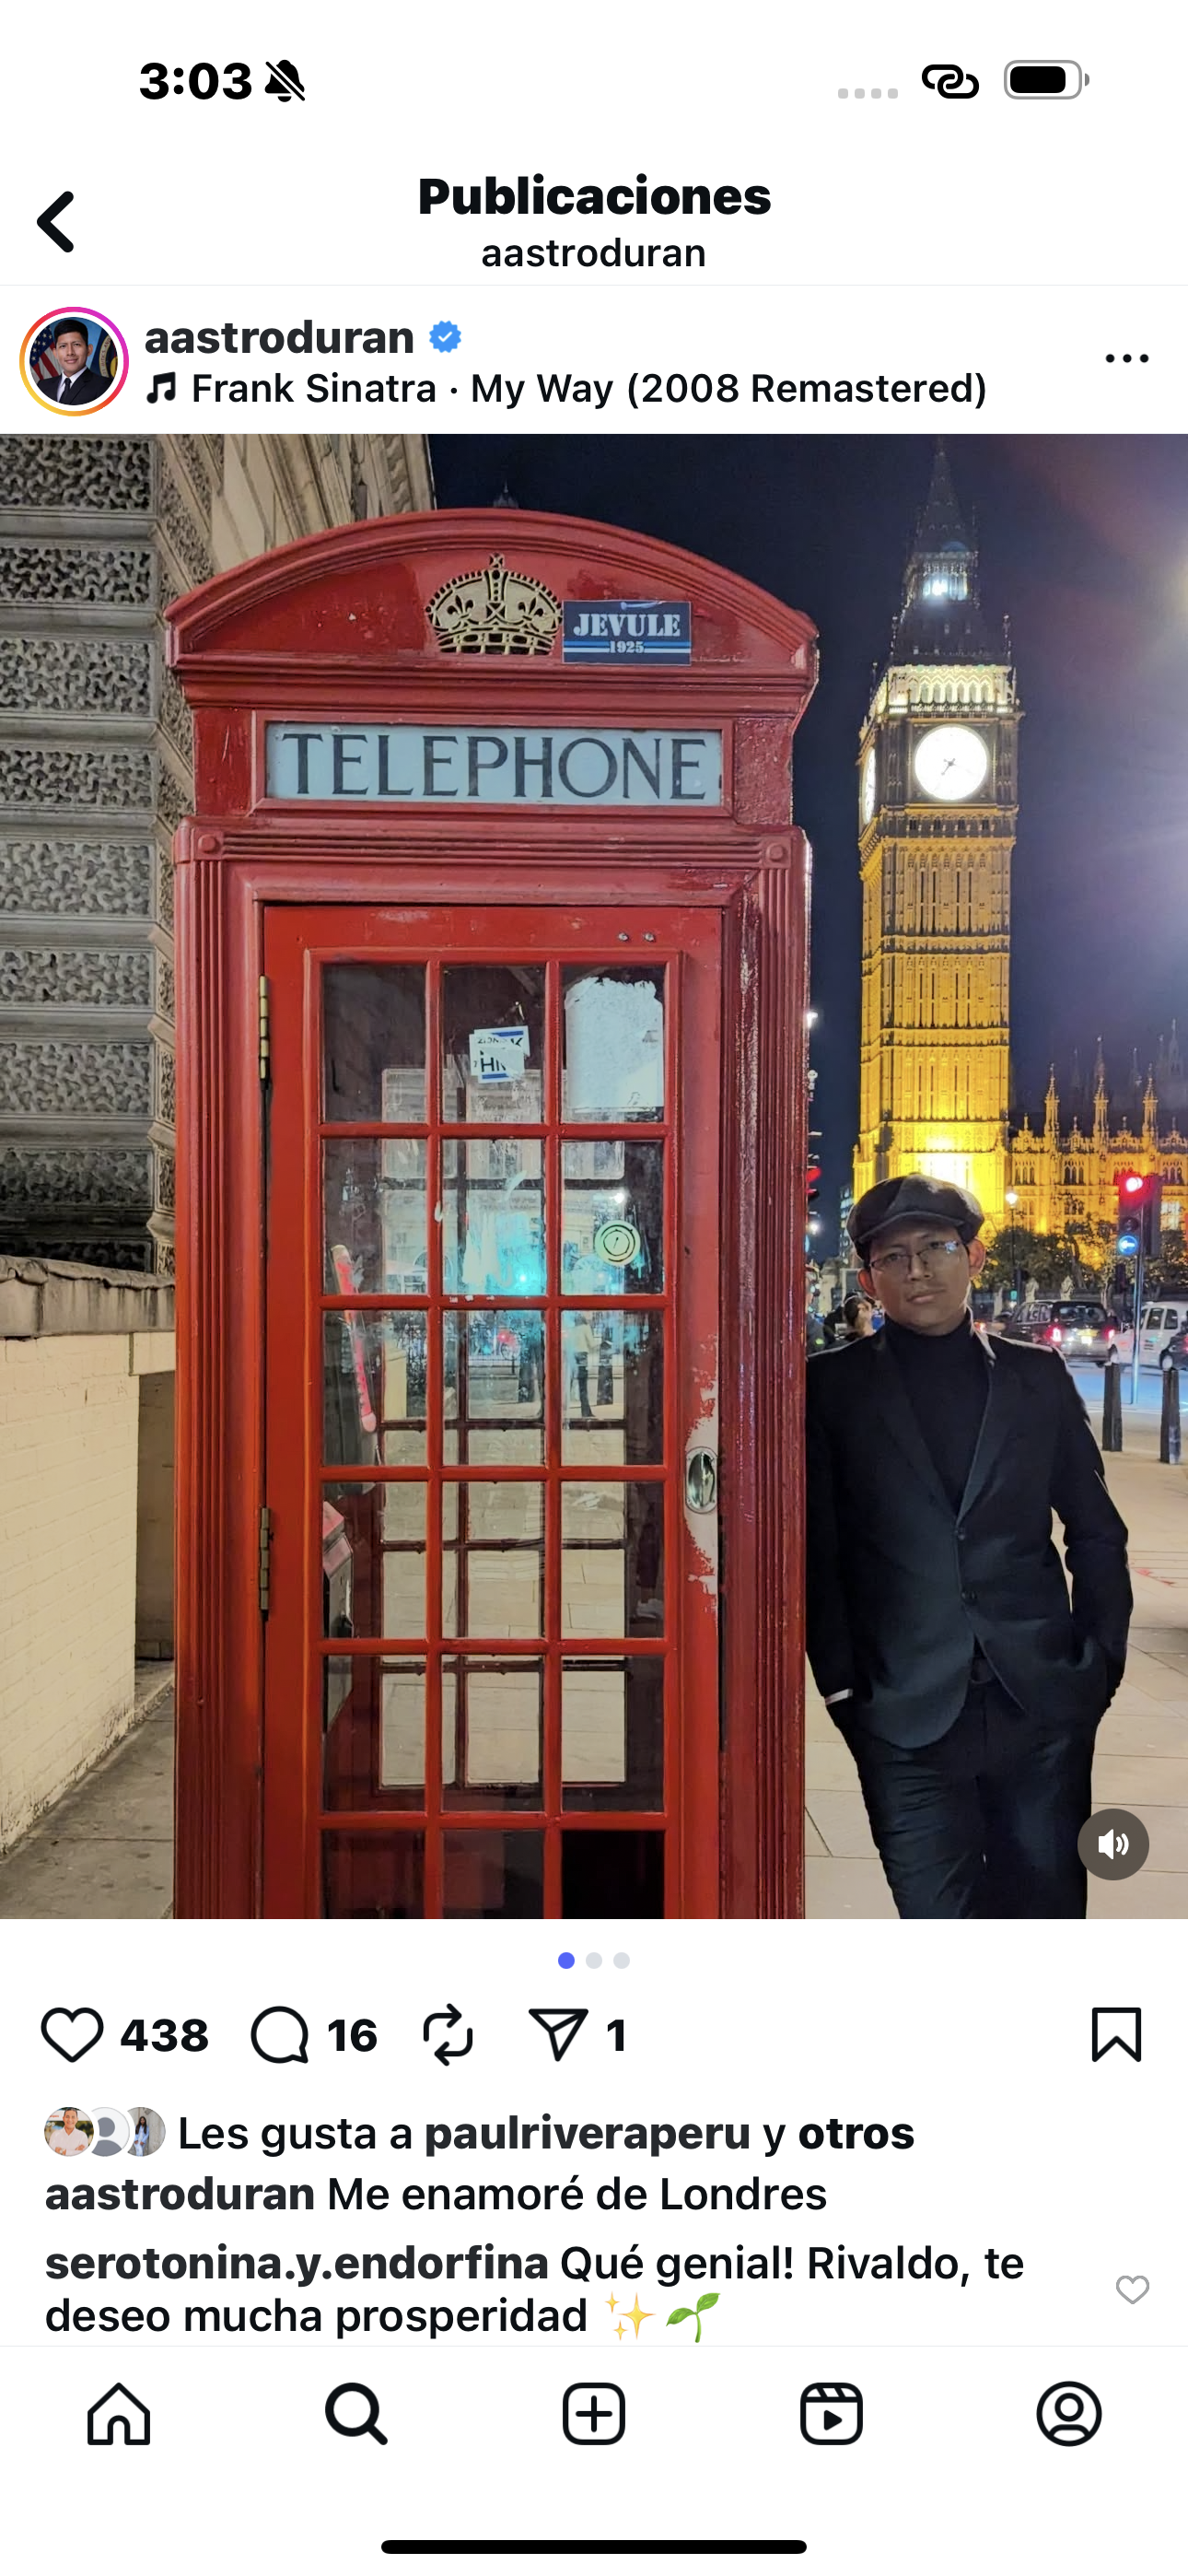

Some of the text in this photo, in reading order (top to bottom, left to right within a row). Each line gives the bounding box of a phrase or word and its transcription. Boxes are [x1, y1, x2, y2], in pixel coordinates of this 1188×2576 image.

[573, 614, 681, 637] JEVULE
[610, 641, 645, 653] 1925
[282, 733, 706, 800] TELEPHONE
